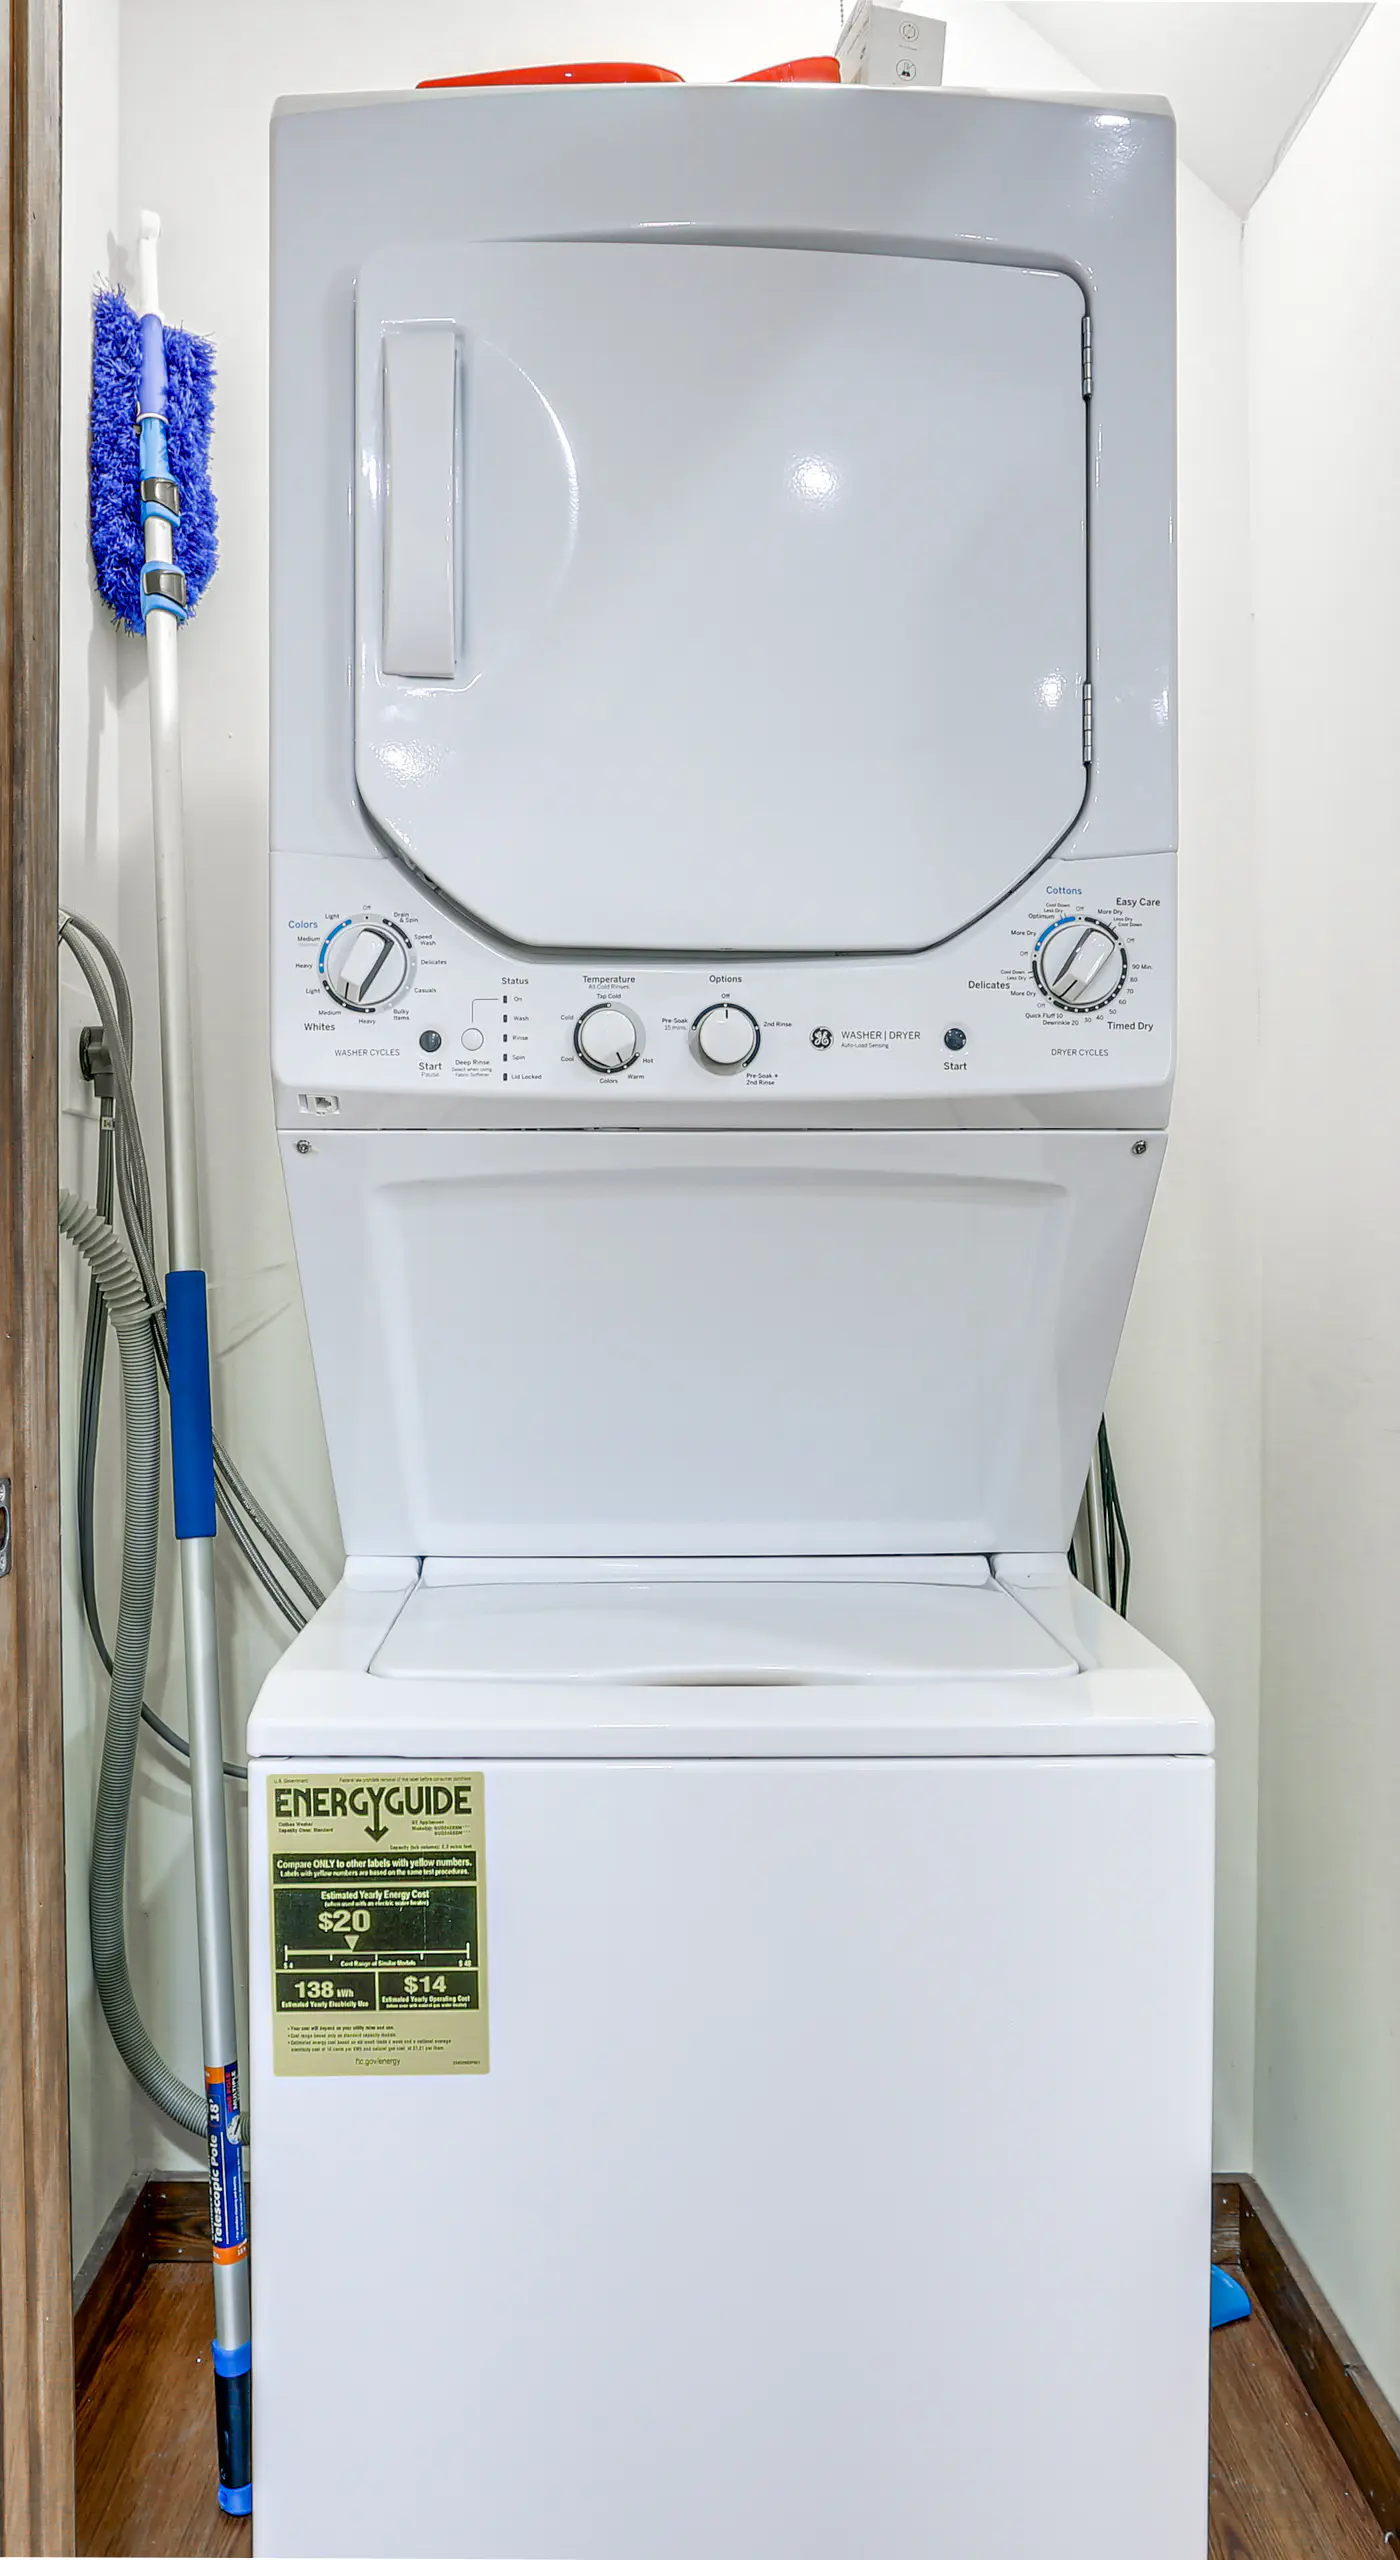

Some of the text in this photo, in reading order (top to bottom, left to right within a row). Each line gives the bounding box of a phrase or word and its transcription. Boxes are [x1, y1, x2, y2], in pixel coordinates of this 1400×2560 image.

[1046, 886, 1082, 895] Cottons
[1116, 898, 1160, 906] Easy Care
[288, 920, 318, 928] Colors
[502, 977, 529, 985] Status
[582, 976, 635, 984] Temperature
[709, 975, 742, 984] Options
[968, 980, 1010, 989] Delicates
[304, 1022, 336, 1032] Whites
[1107, 1022, 1154, 1032] Timed Dry
[841, 1031, 920, 1040] WASHER DRYER
[419, 1062, 442, 1071] Start
[944, 1062, 967, 1070] Start
[275, 1786, 472, 1818] ENERGYGUIDE
[277, 1857, 472, 1869] Compare ONLY to other labels with yellow numbers.
[320, 1890, 430, 1901] Estimated Yearly Energy Cost
[318, 1910, 371, 1932] $20
[404, 1975, 446, 1994] $14
[294, 1981, 354, 1998] 138 kWh
[210, 2135, 219, 2167] Pole
[212, 2168, 223, 2244] Telescopic
